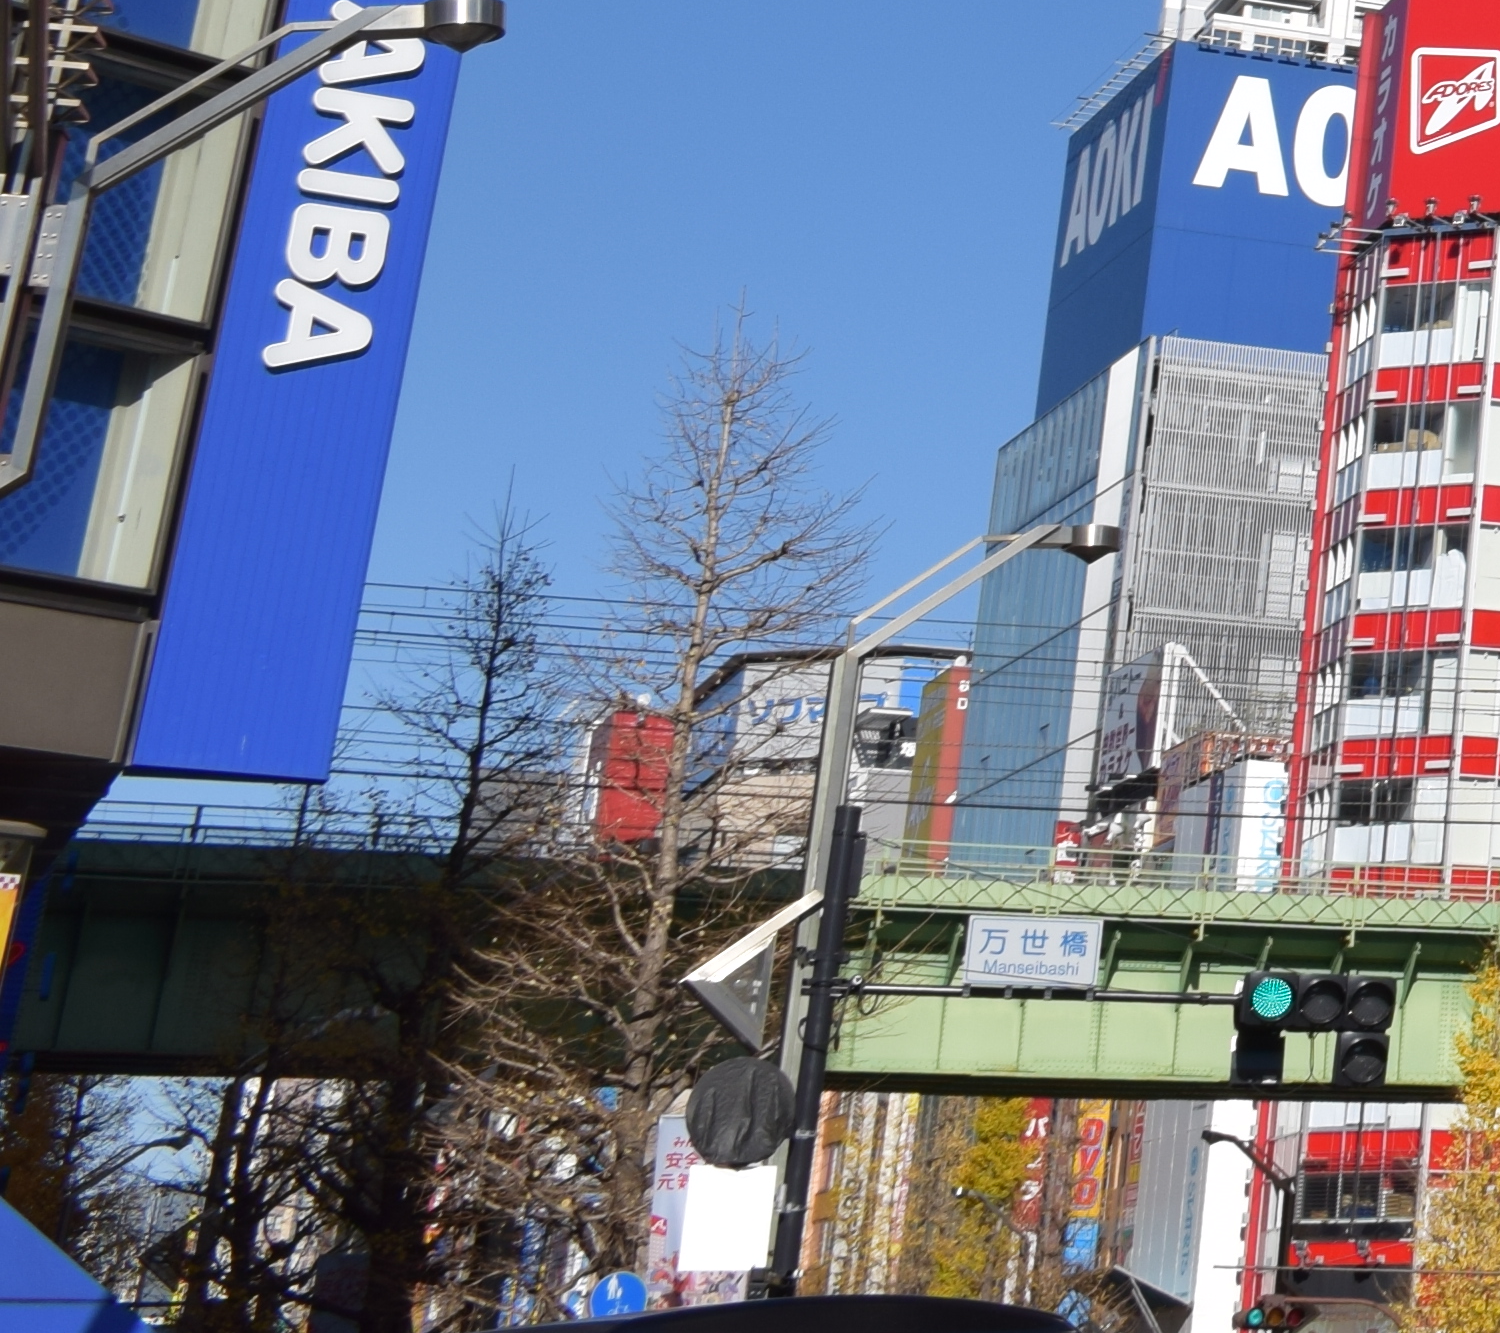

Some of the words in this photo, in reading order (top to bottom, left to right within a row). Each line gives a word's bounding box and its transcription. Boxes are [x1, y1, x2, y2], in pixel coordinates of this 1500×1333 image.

[1364, 11, 1401, 229] カラオケ
[1421, 73, 1496, 105] ADORES
[261, 0, 426, 371] AKIBA
[1060, 95, 1158, 268] AOKI
[979, 929, 1088, 957] 万世橋
[982, 959, 1080, 978] Manseibashi
